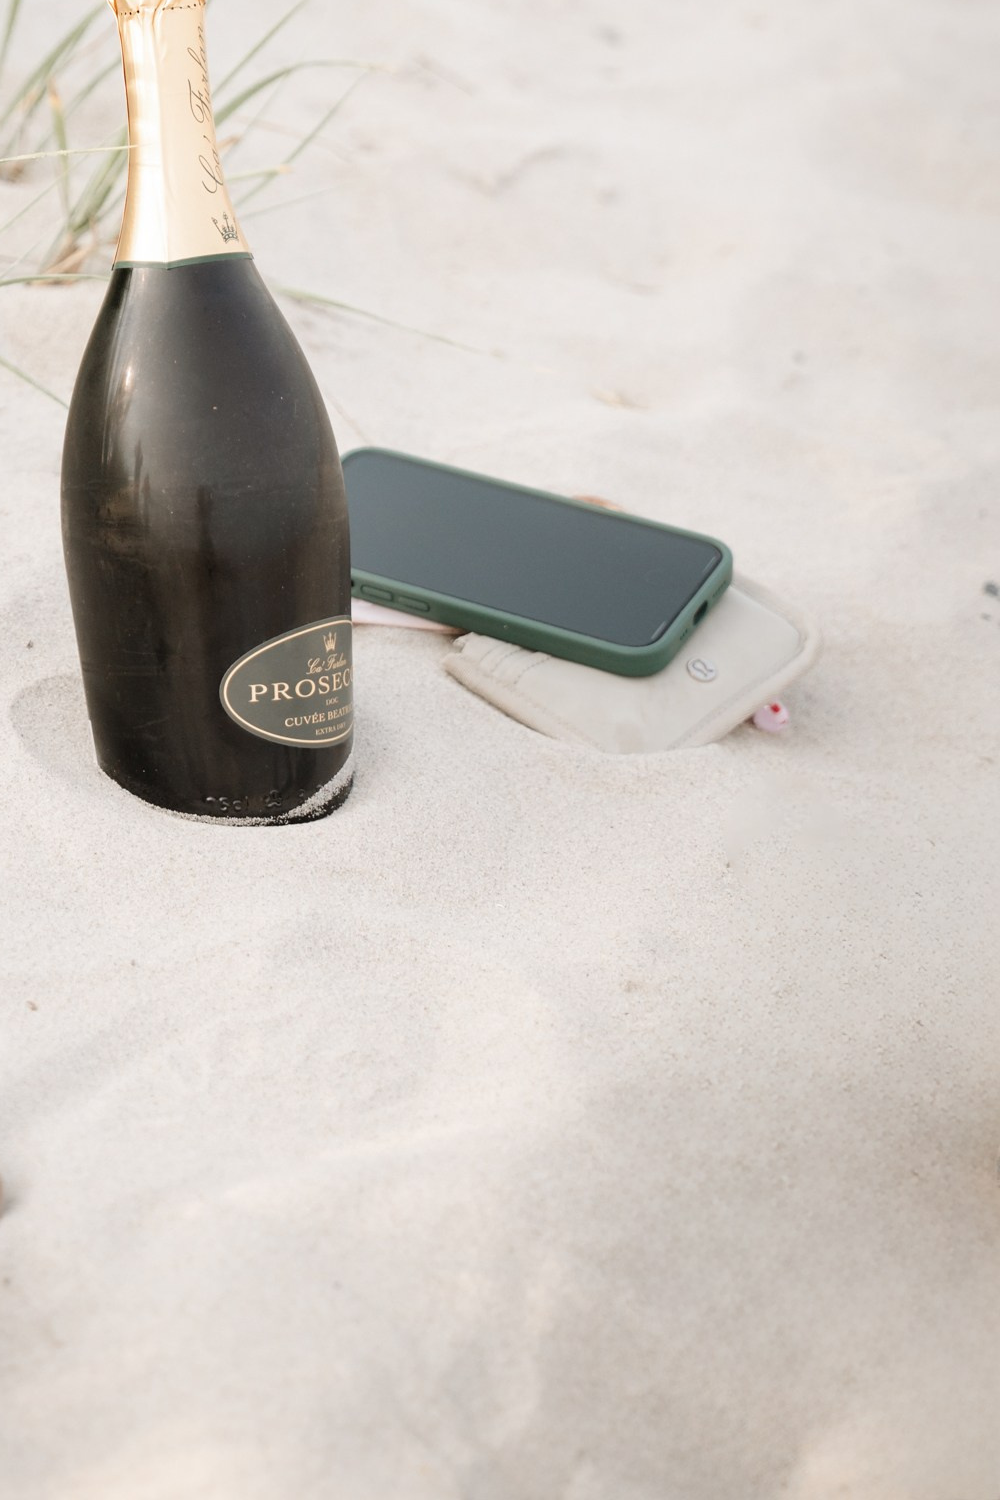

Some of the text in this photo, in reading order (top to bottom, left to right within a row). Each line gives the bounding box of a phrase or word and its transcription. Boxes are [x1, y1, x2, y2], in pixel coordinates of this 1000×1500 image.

[325, 696, 339, 706] DOC
[284, 711, 325, 727] CUVÉE
[314, 725, 336, 736] EXTRA
